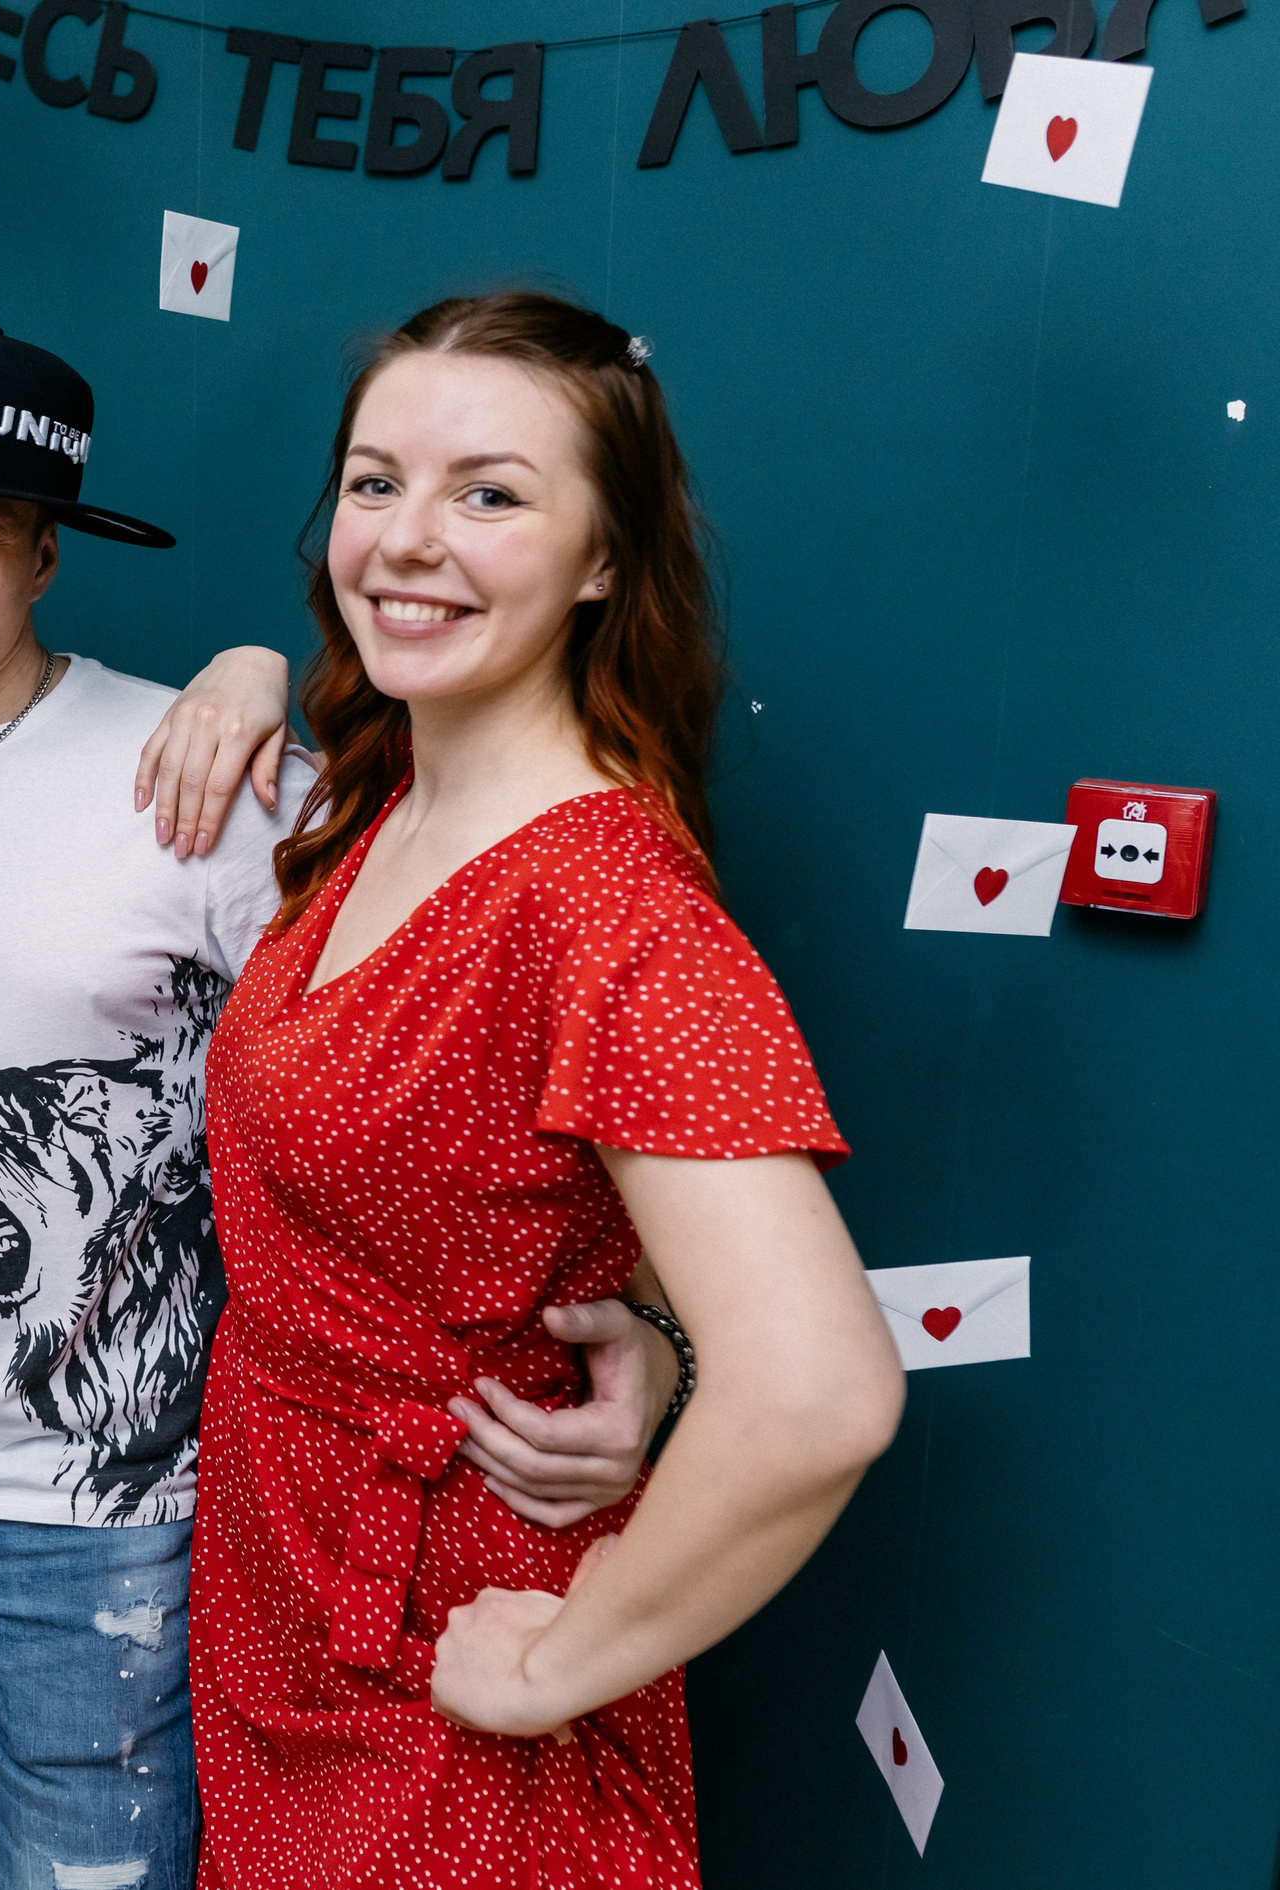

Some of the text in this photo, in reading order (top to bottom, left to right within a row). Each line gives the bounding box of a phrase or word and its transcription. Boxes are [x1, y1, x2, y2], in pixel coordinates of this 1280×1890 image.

[226, 26, 544, 181] ТЕБЯ
[53, 421, 80, 441] TO BE
